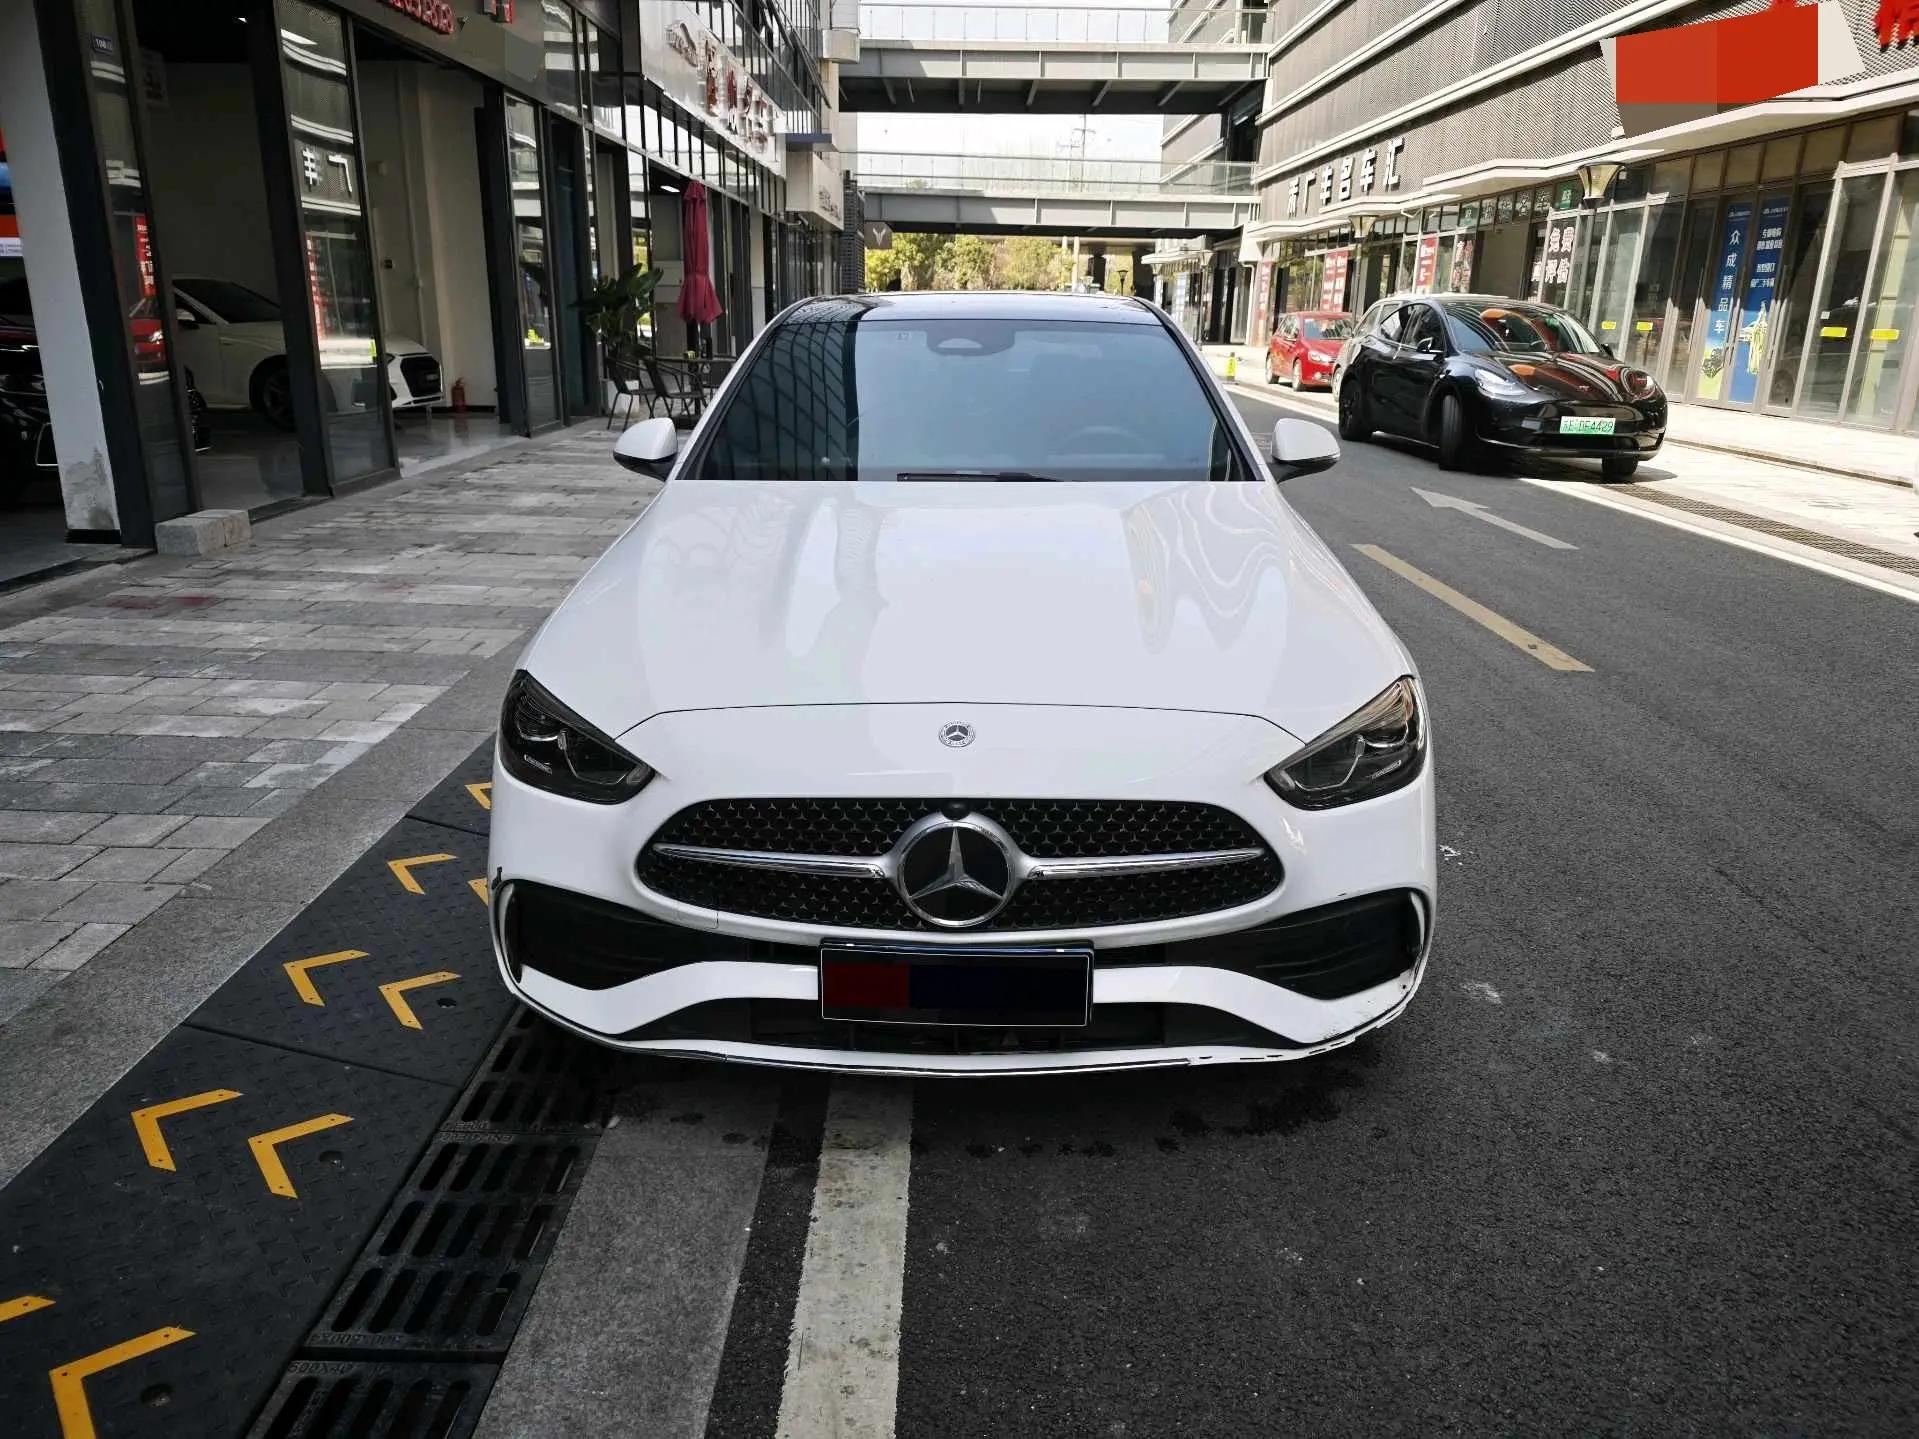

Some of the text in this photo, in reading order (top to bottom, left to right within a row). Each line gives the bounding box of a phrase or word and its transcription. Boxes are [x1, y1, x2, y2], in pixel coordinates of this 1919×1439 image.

[1713, 229, 1741, 334] 众成精品车
